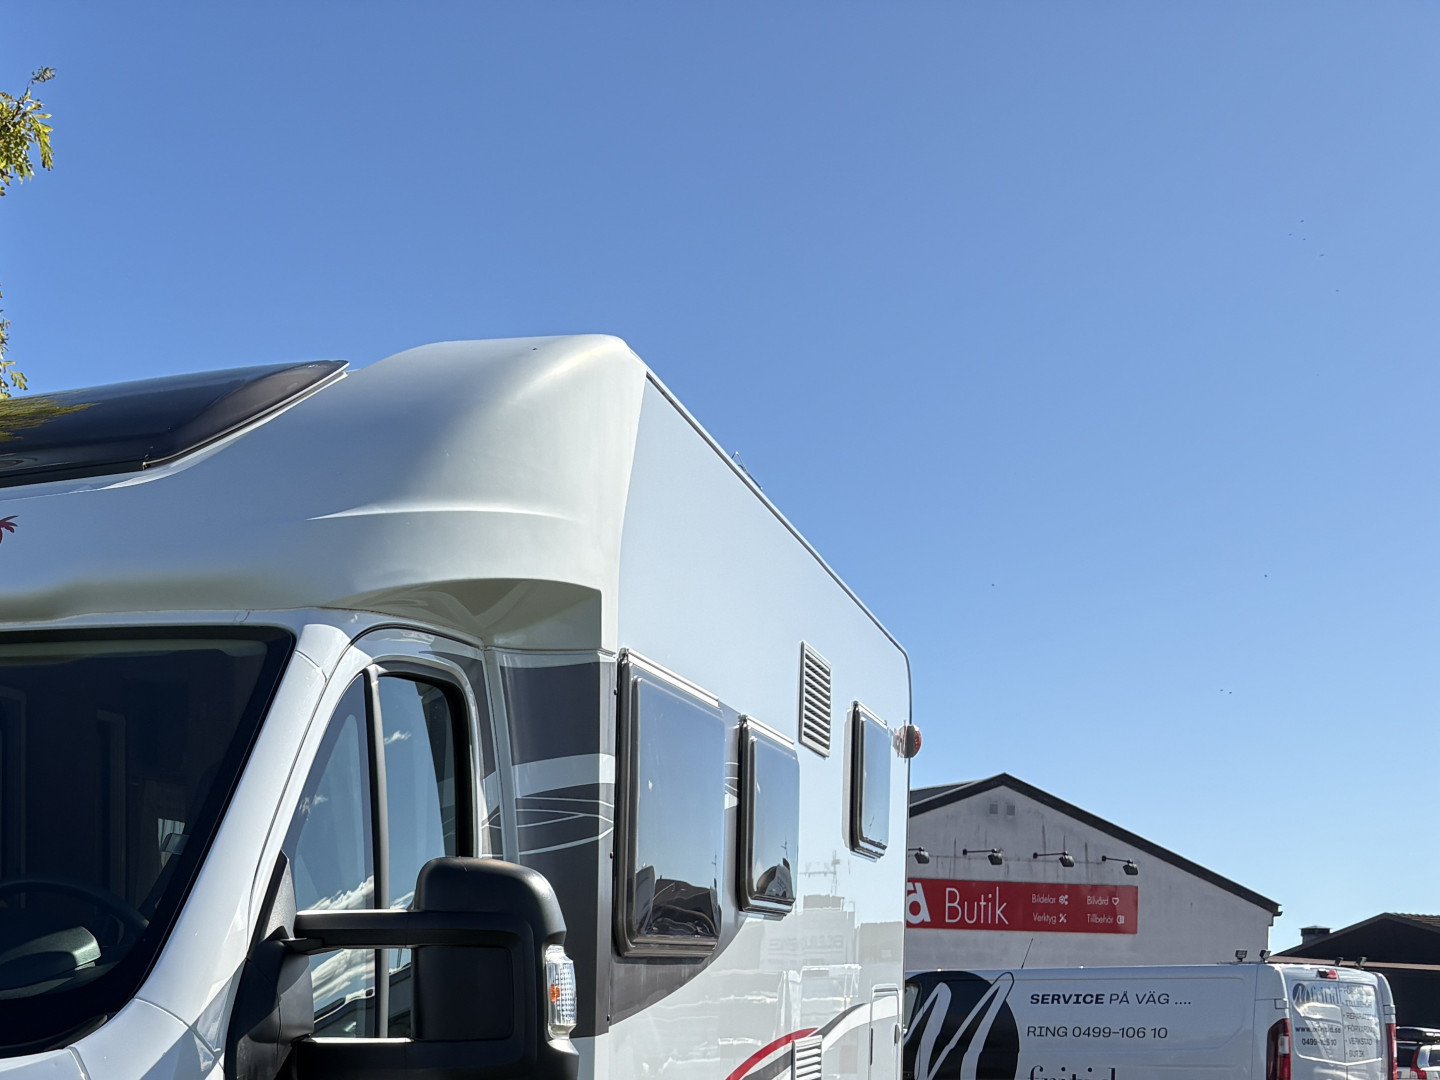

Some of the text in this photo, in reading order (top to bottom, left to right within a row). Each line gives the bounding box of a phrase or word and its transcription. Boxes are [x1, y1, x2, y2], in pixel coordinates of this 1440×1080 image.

[945, 886, 1009, 924] Butik
[1031, 893, 1057, 904] Bildelar
[1086, 895, 1109, 906] Bilvård
[1032, 912, 1057, 925] Verktyg
[1086, 913, 1114, 924] Tillbehör
[1030, 993, 1106, 1005] SERVICE
[1110, 991, 1130, 1005] PÅ
[1135, 991, 1170, 1005] VÄG
[1026, 1026, 1168, 1039] RING 0499-106 10
